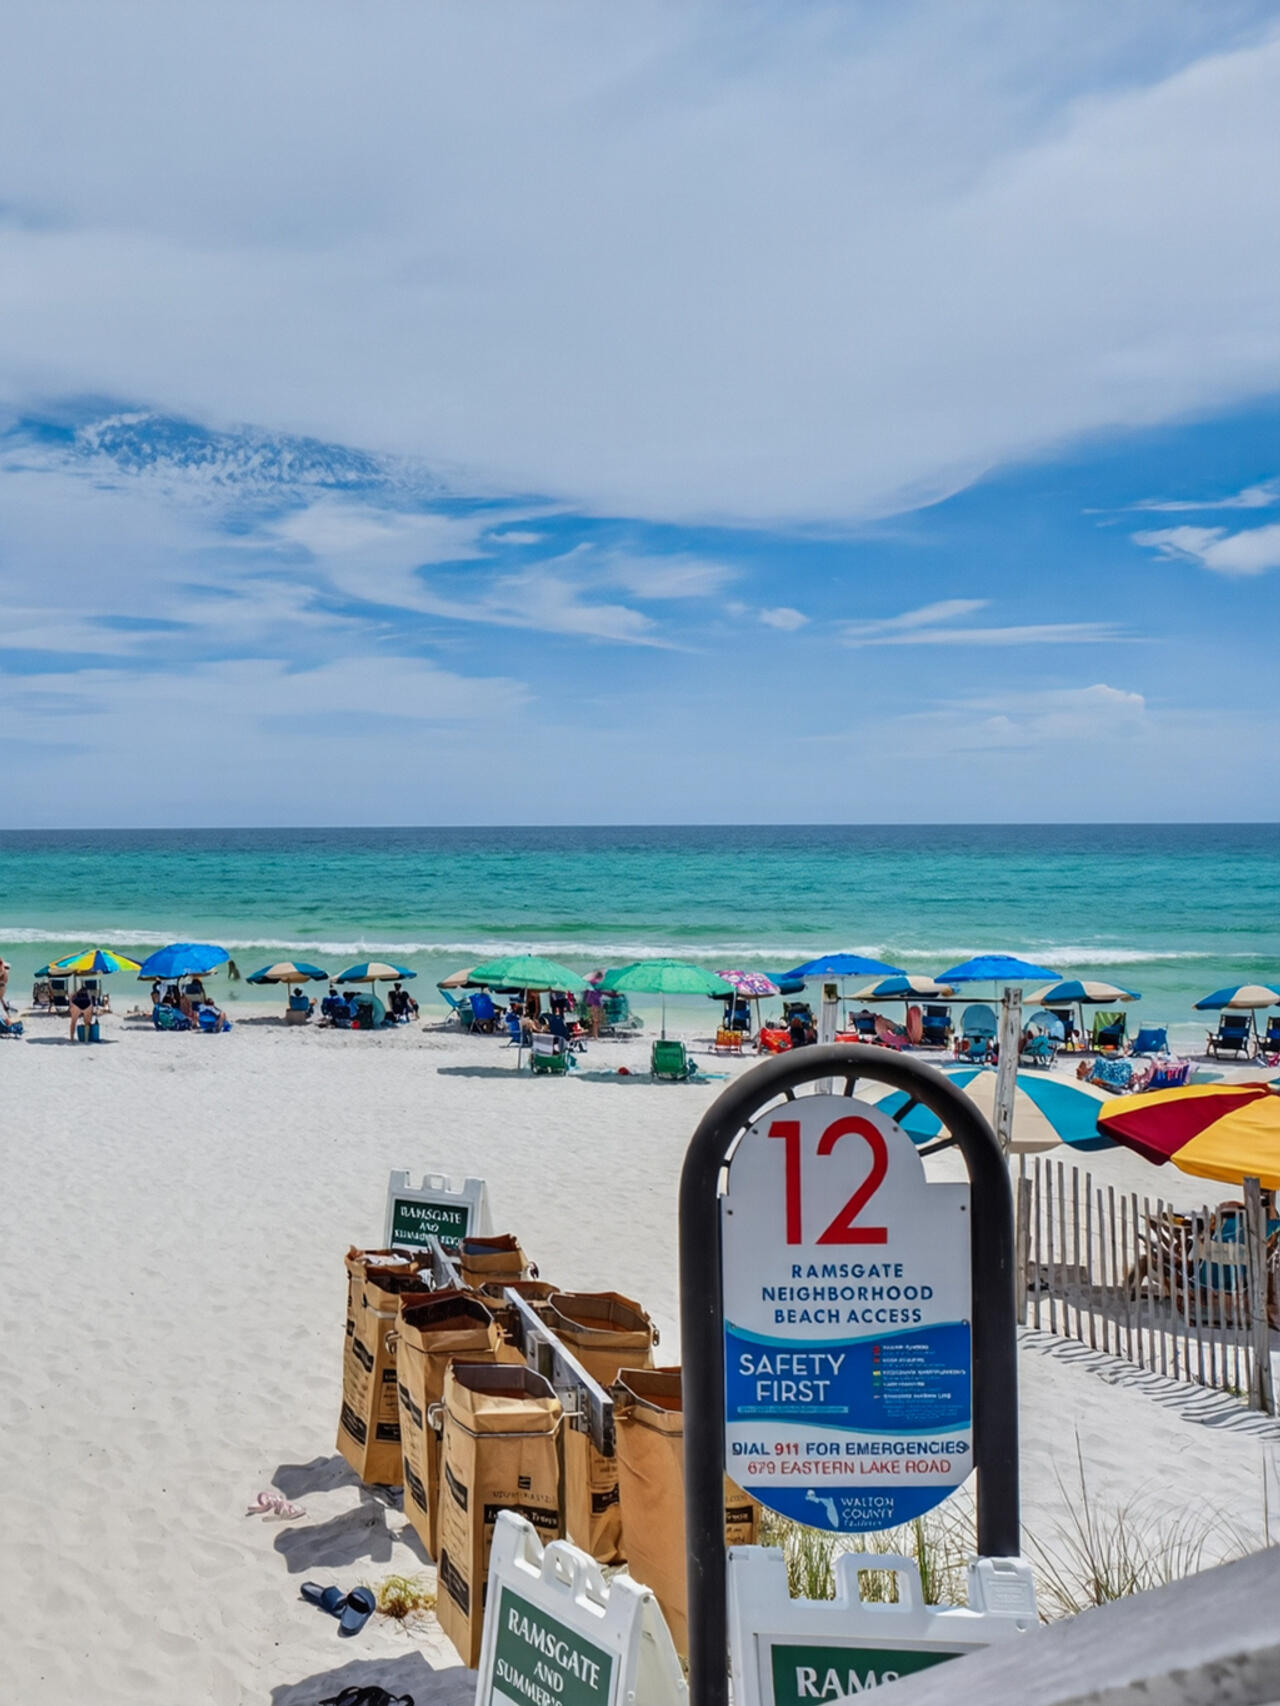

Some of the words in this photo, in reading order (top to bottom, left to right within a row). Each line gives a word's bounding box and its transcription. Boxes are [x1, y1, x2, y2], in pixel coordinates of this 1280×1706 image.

[768, 1115, 889, 1245] 12
[791, 1263, 904, 1278] RAMSGATE
[762, 1286, 933, 1301] NEIGHBORHOOD
[774, 1309, 840, 1323] BEACH
[847, 1308, 922, 1323] ACCESS
[739, 1353, 846, 1376] SAFETY
[756, 1380, 831, 1402] FIRST
[732, 1442, 770, 1455] DIAL
[774, 1442, 799, 1456] 911
[806, 1442, 840, 1455] FOR
[846, 1440, 969, 1455] EMERGENCIES
[781, 1460, 854, 1475] EASTERN
[860, 1460, 900, 1475] LAKE
[905, 1459, 951, 1474] ROAD
[841, 1496, 894, 1507] WALTON
[842, 1508, 894, 1519] COUNTY
[508, 1607, 600, 1690] RAMSGATE
[533, 1661, 564, 1692] AND
